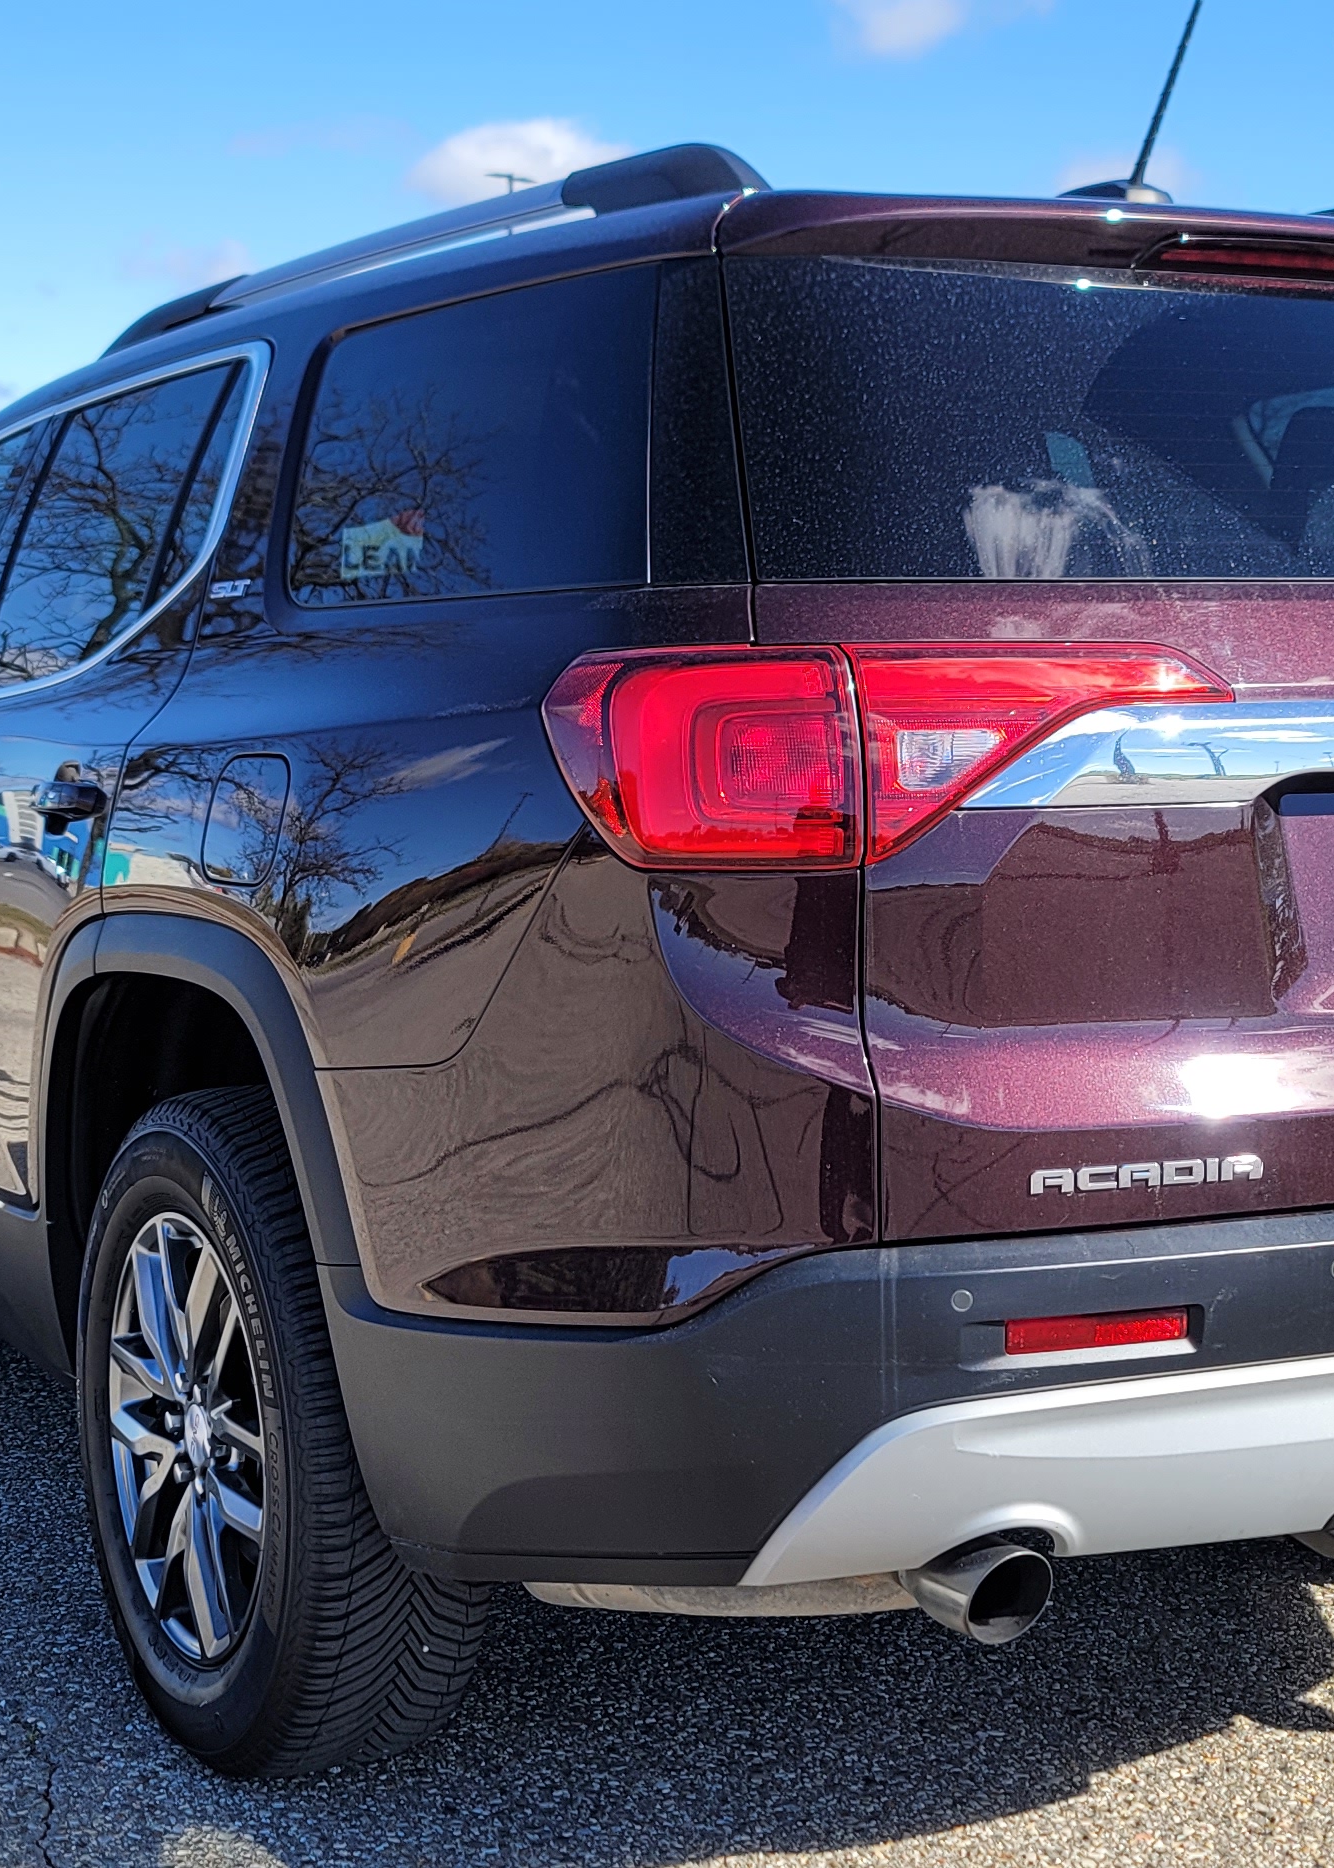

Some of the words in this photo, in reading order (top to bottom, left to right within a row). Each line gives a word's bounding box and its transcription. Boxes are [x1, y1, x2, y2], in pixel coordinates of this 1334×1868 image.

[210, 578, 251, 599] SLT
[1030, 1154, 1264, 1195] ACADIA
[225, 1233, 275, 1398] MICHELIN
